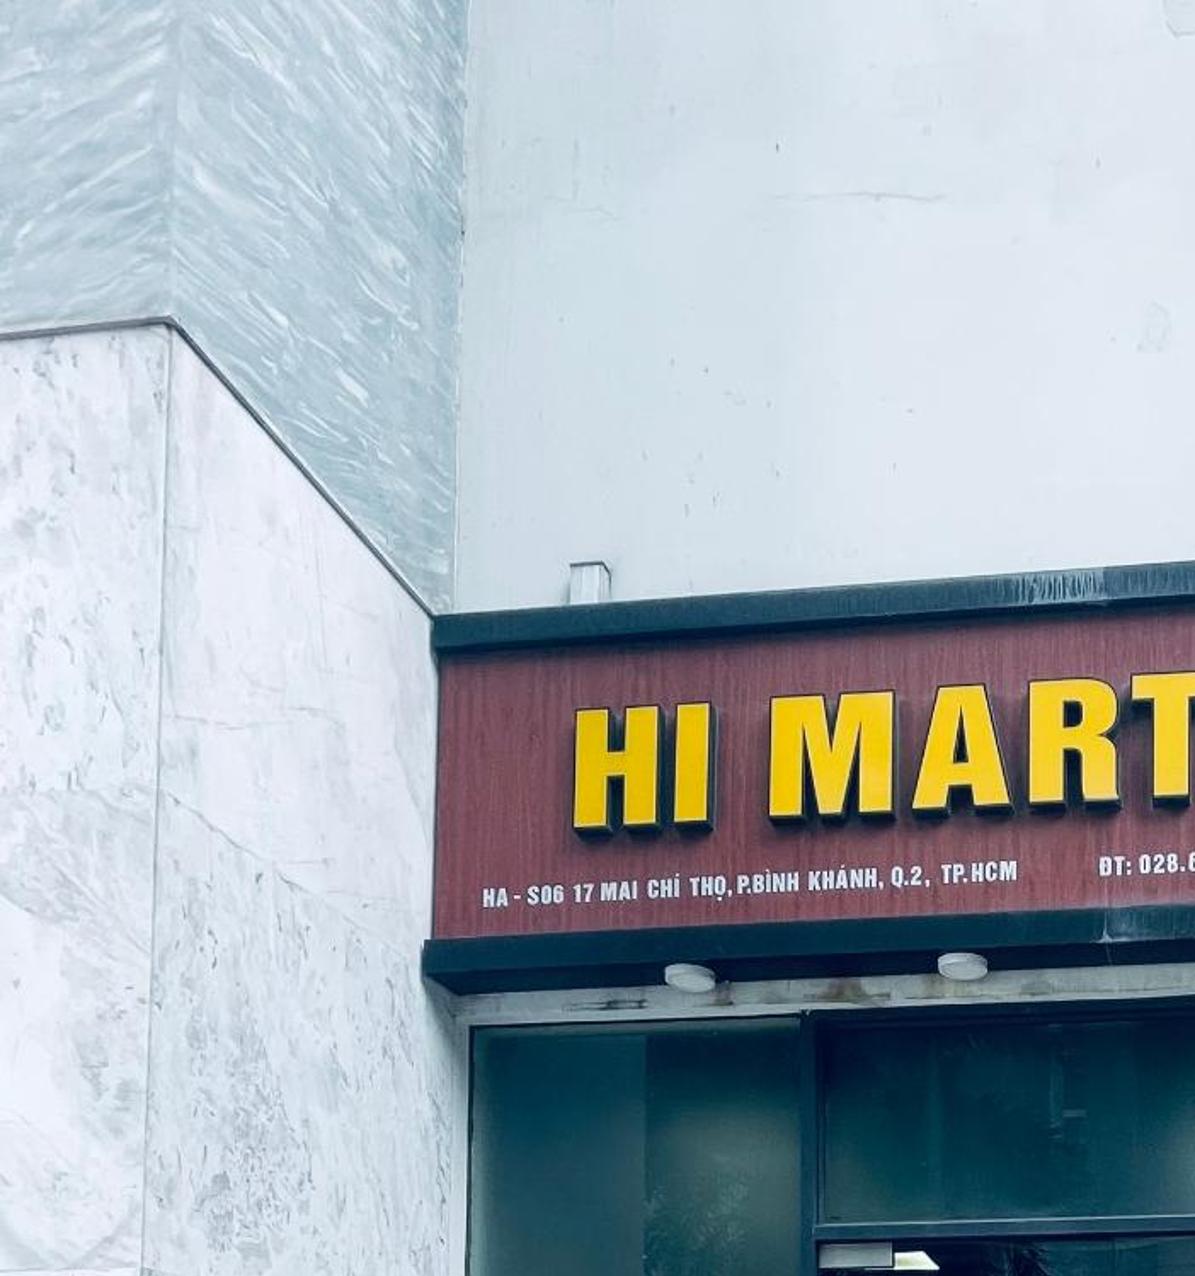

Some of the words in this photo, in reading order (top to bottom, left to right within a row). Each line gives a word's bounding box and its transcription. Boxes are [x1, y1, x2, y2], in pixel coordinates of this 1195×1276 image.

[573, 702, 714, 834] HI
[482, 888, 508, 908] HA
[573, 883, 594, 903] 17
[601, 880, 638, 901] MAI
[647, 873, 680, 898] CHÍ
[808, 865, 884, 891] KHÁNH,
[891, 865, 930, 888] Q.2,
[1099, 856, 1132, 877] ĐT:
